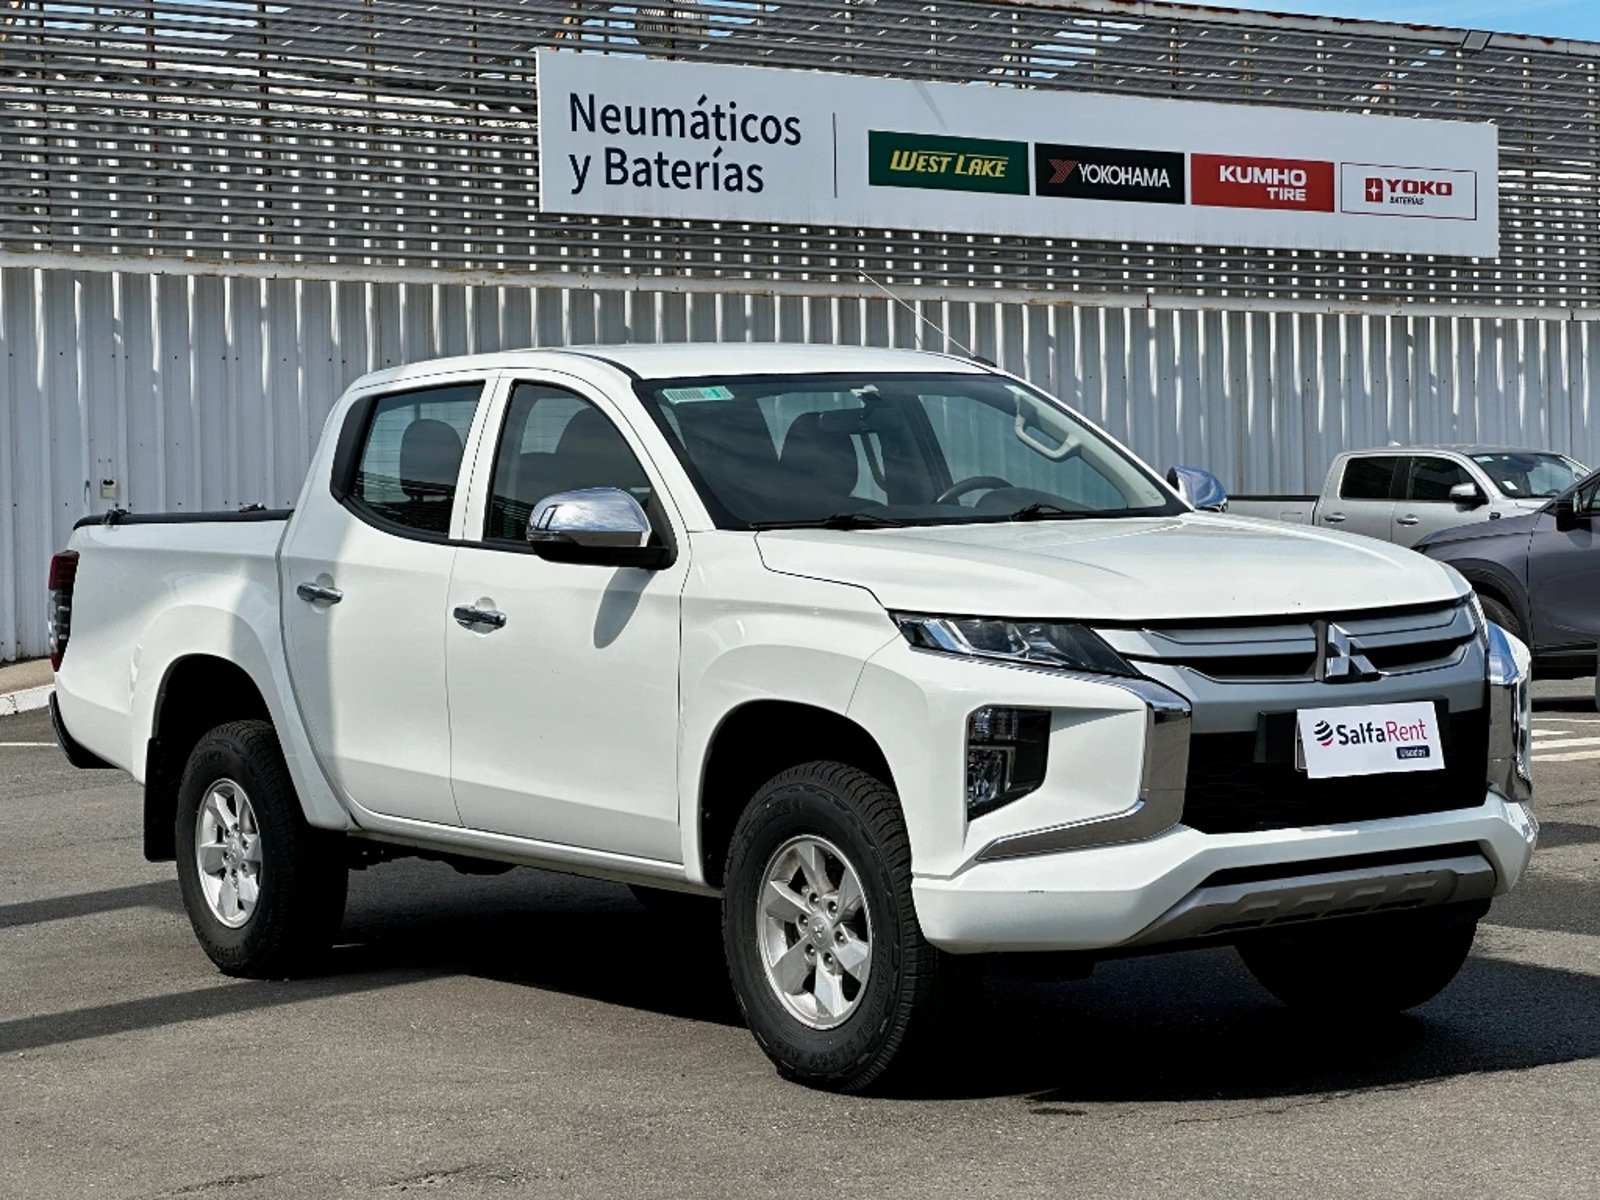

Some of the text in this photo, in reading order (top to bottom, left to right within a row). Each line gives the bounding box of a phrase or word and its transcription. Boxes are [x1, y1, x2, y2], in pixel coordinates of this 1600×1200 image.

[569, 92, 802, 146] Neumáticos
[568, 145, 765, 195] y Baterías
[890, 149, 1009, 178] WEST LAKE
[1078, 163, 1171, 189] YOKOHAMA
[1219, 164, 1307, 187] KUMHO
[1266, 186, 1306, 202] TIRE
[1385, 178, 1453, 197] YOKO
[1335, 718, 1428, 746] SalfaRent
